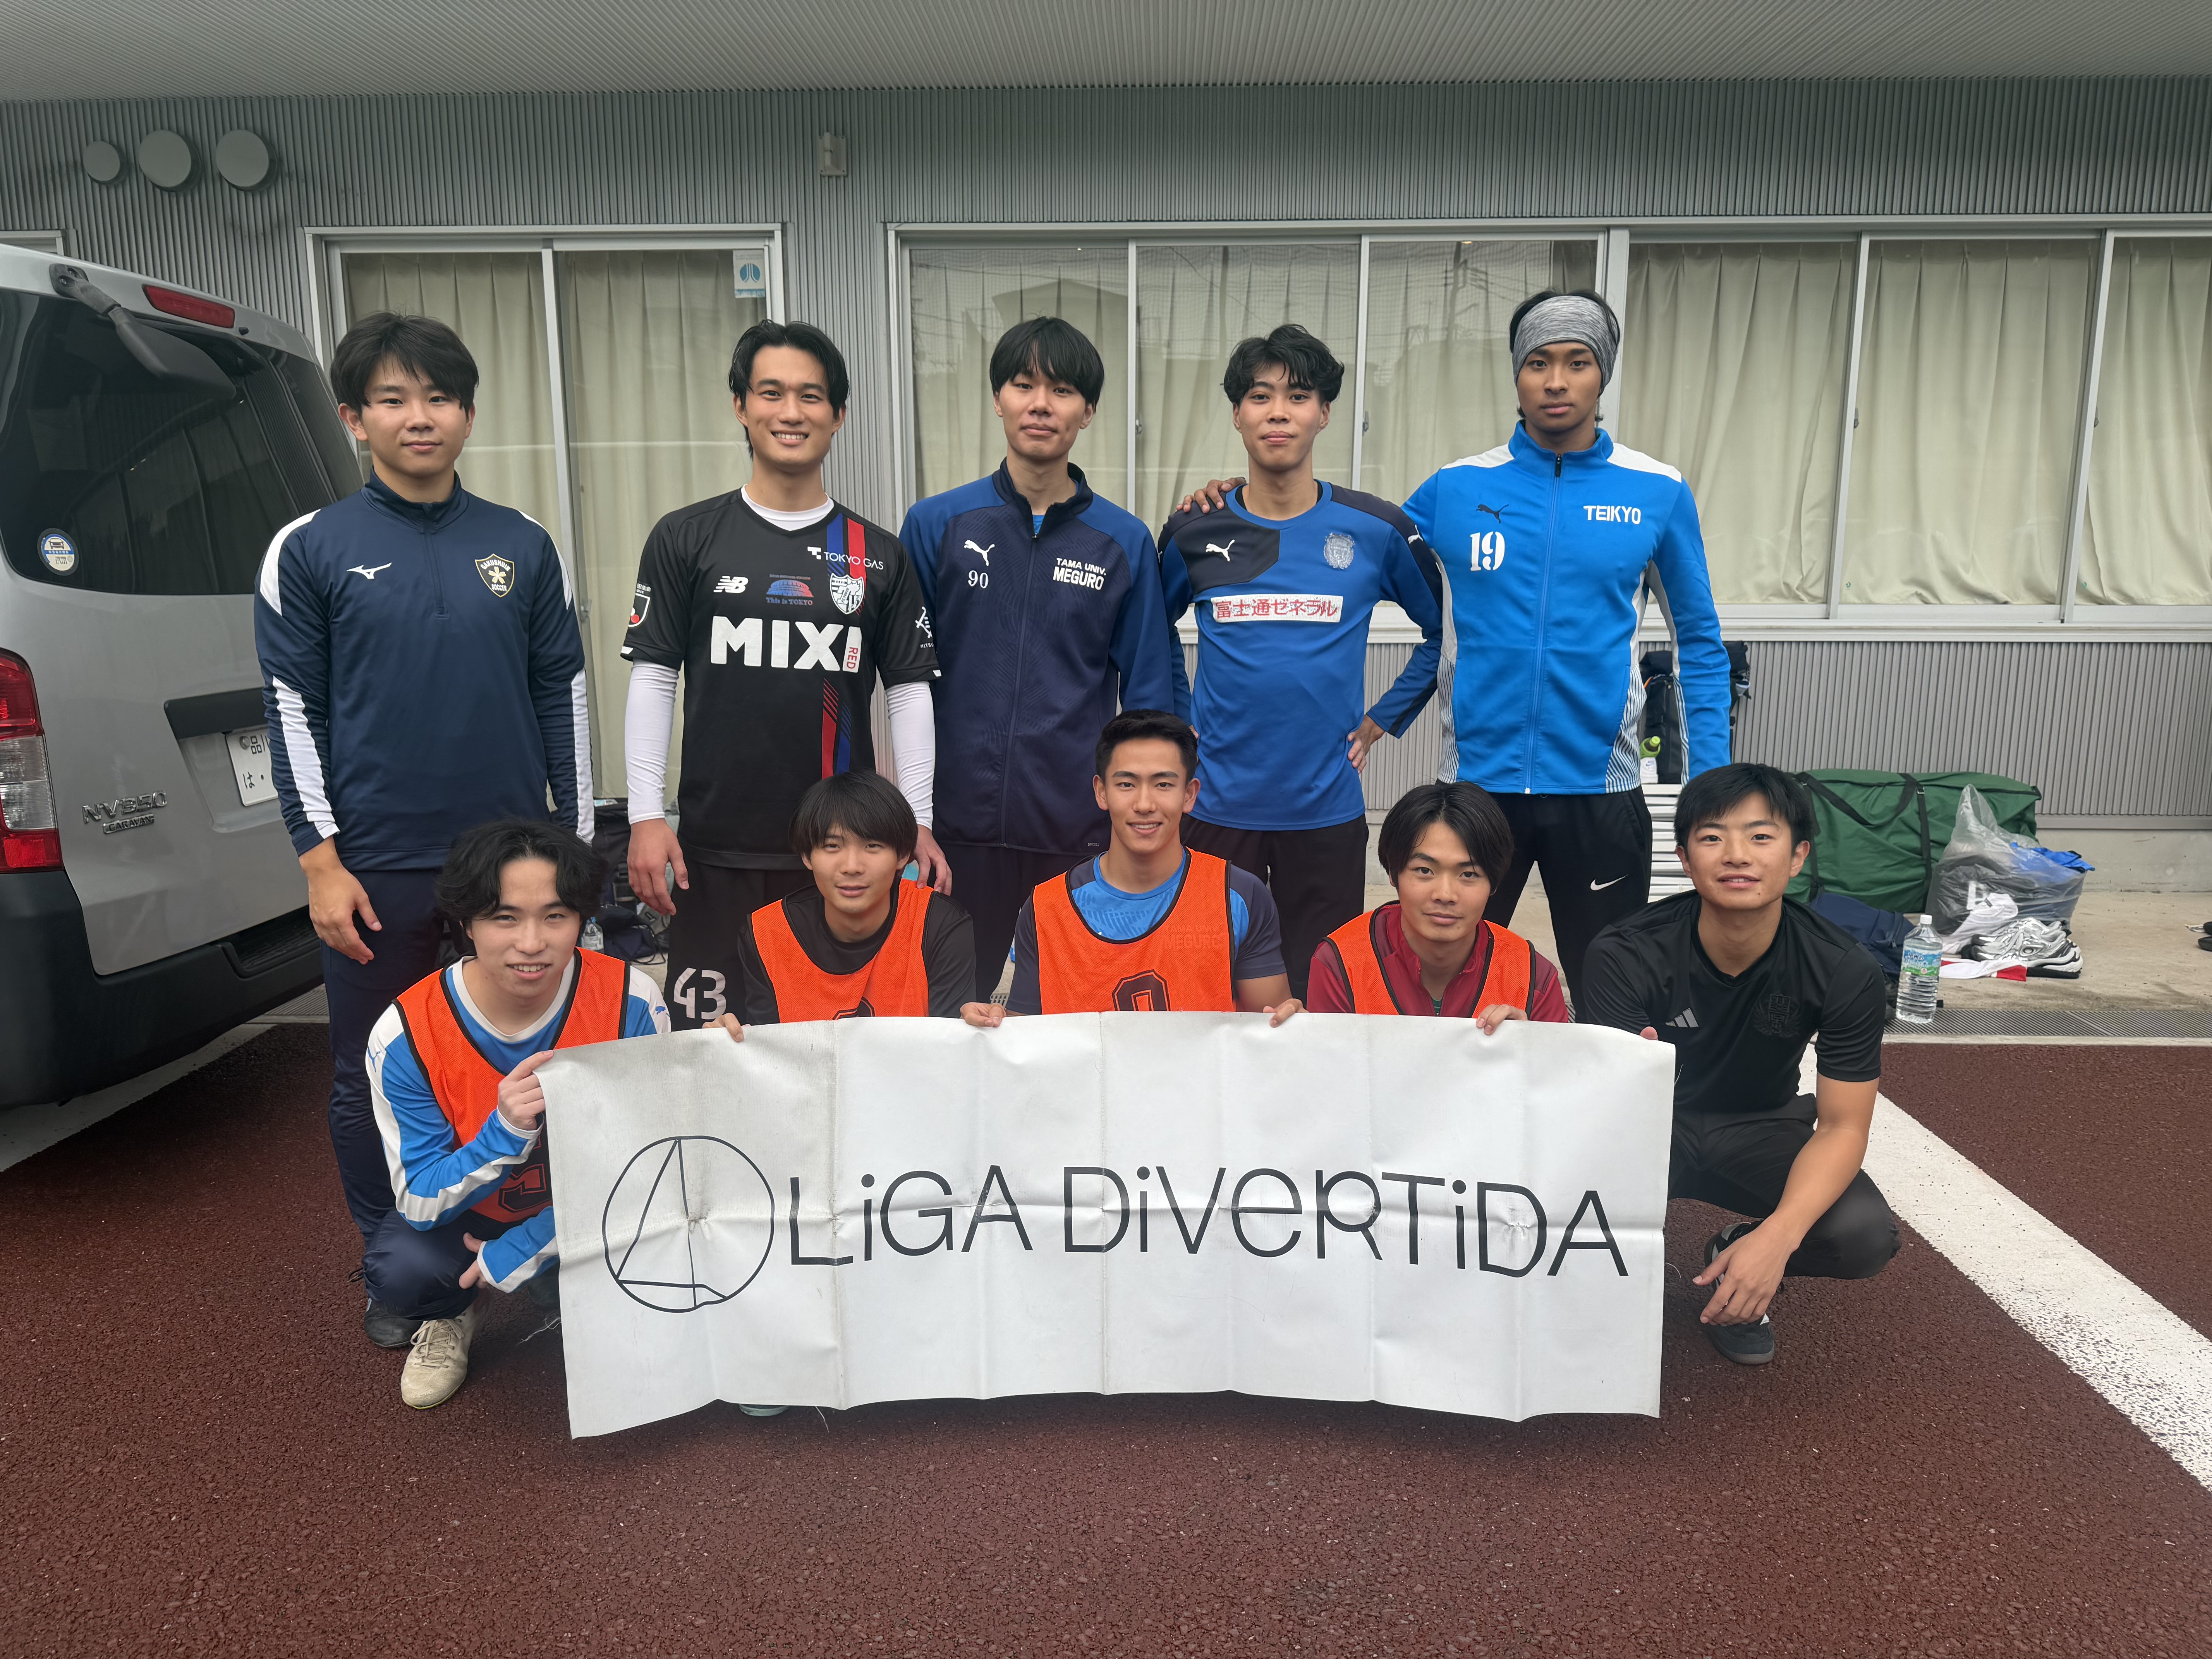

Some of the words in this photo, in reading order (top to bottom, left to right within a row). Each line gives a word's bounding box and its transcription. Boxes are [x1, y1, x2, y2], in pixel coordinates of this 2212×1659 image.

[1583, 505, 1641, 525] TEIKYO
[824, 552, 861, 565] TOKYO
[863, 558, 883, 570] GAS
[1470, 531, 1505, 571] 19
[1056, 557, 1082, 570] TAMA
[1084, 563, 1106, 576] UNIV.
[968, 570, 989, 589] 90
[1053, 566, 1104, 590] MEGURO
[1216, 599, 1337, 619] 富士通ゼネラル
[711, 616, 862, 673] MIXI
[846, 647, 859, 669] RED
[242, 771, 255, 789] は
[82, 790, 168, 824] NV350
[109, 815, 152, 831] CARAVAN
[673, 967, 726, 1020] 43
